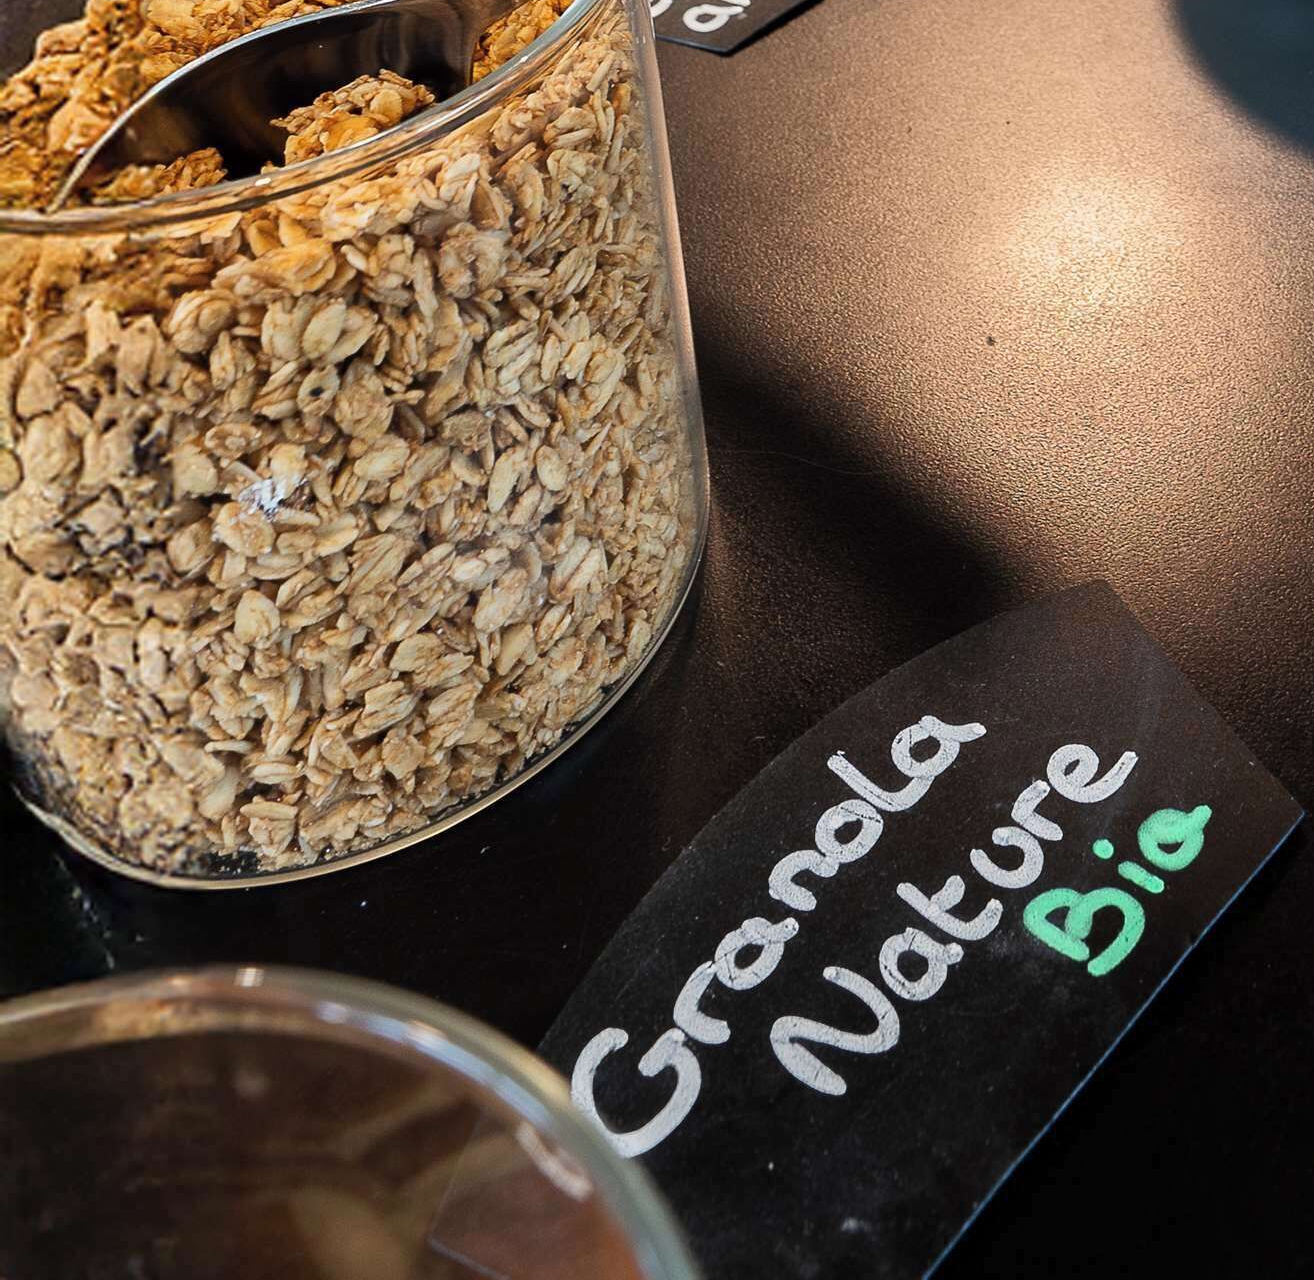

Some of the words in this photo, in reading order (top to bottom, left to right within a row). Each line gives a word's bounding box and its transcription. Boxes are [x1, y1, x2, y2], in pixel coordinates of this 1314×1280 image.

[570, 713, 988, 1159] Granola
[768, 742, 1138, 1097] Nature
[1022, 803, 1214, 978] Bio
